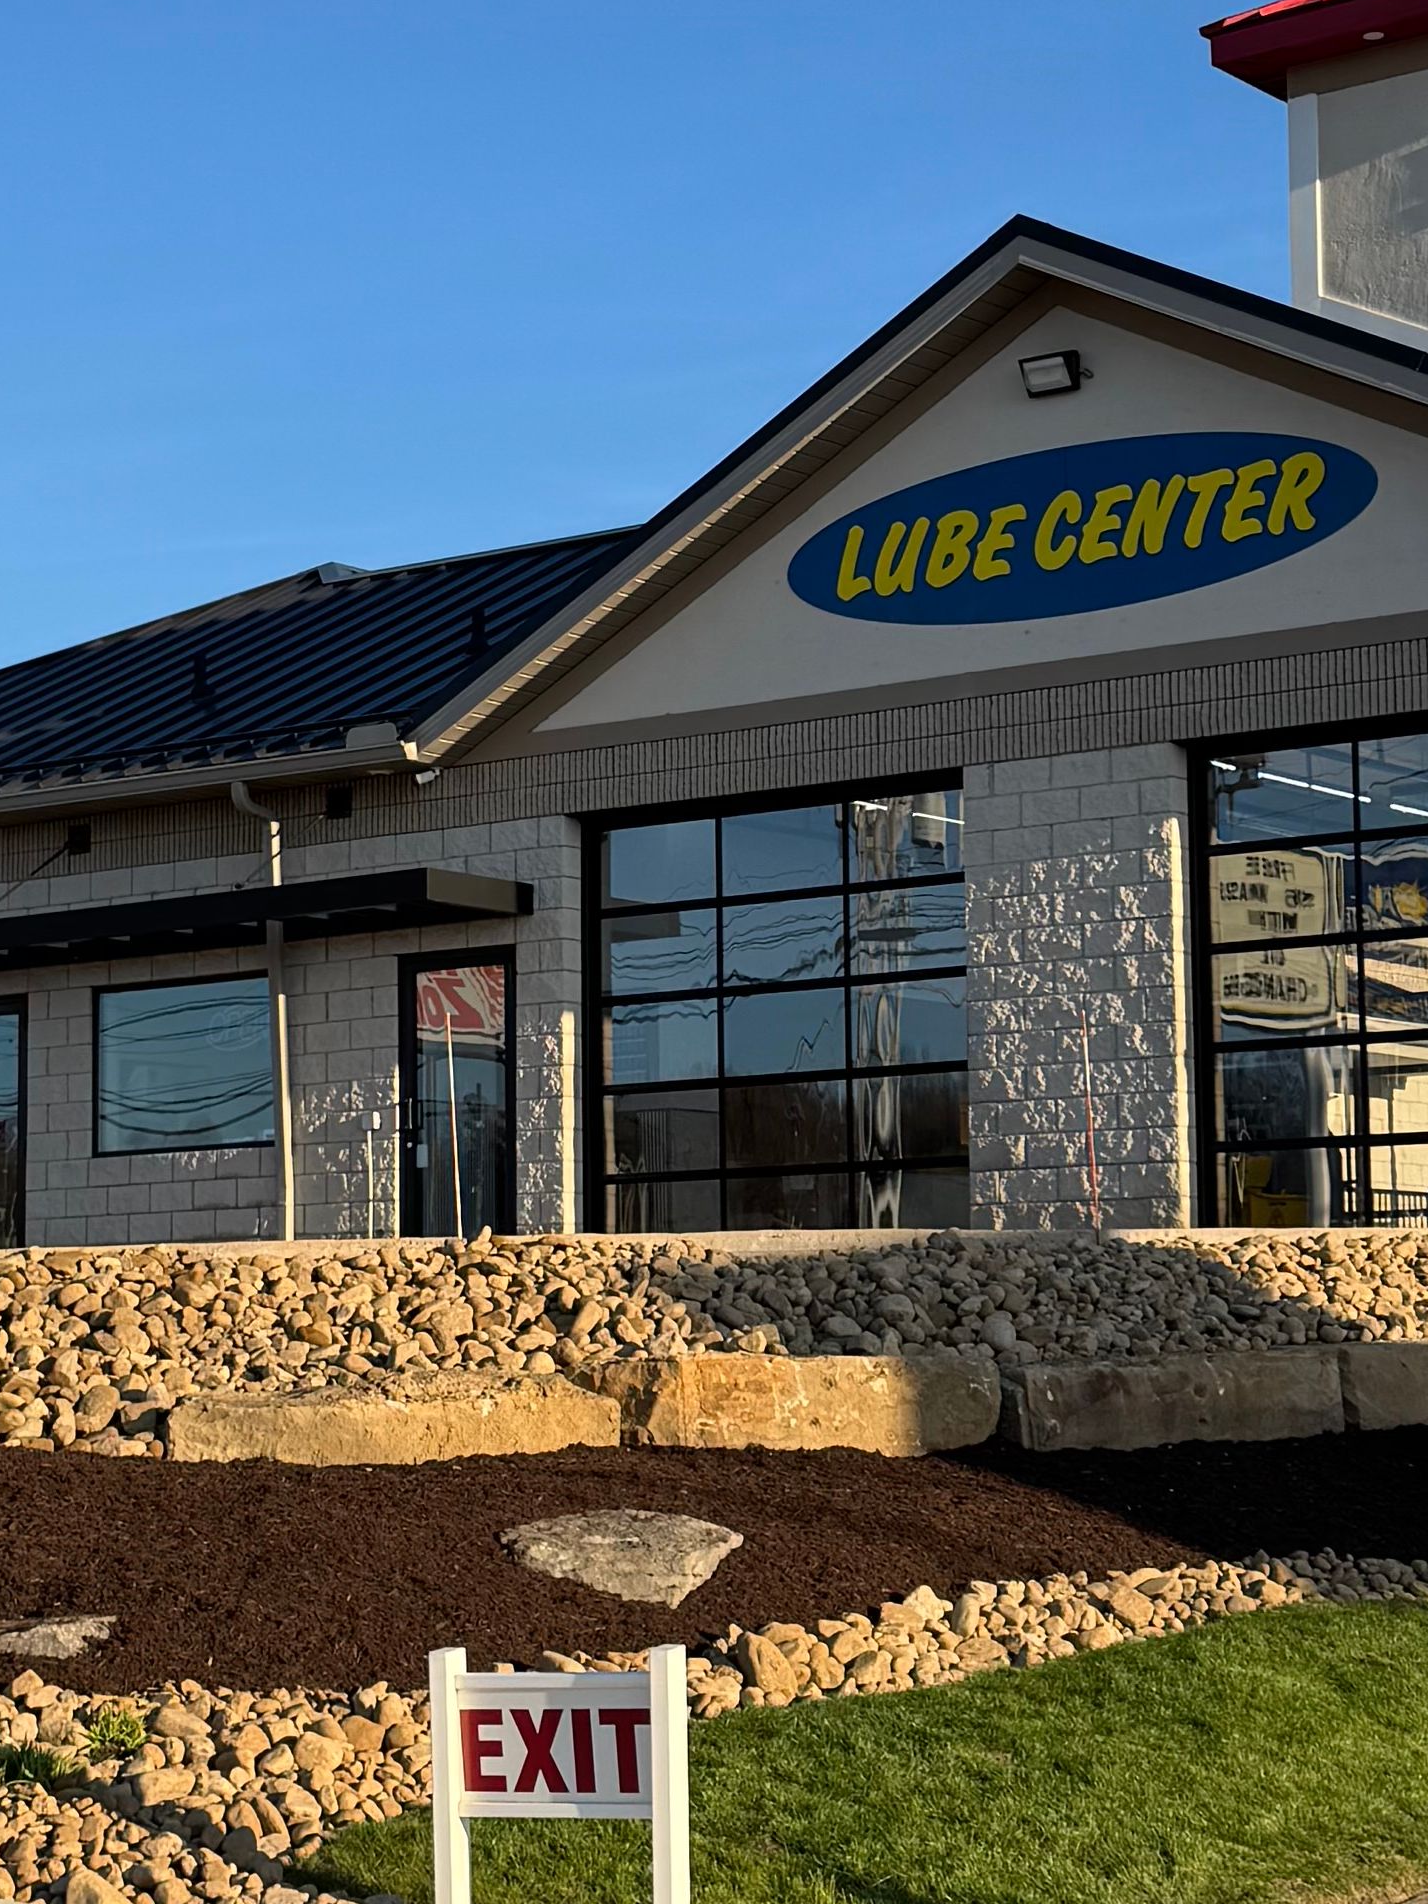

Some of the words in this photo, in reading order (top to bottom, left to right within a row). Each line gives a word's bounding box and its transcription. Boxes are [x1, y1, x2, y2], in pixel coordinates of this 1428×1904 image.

[836, 503, 1027, 602] LUBE
[1033, 451, 1327, 572] CENTER
[460, 1709, 651, 1793] EXIT
